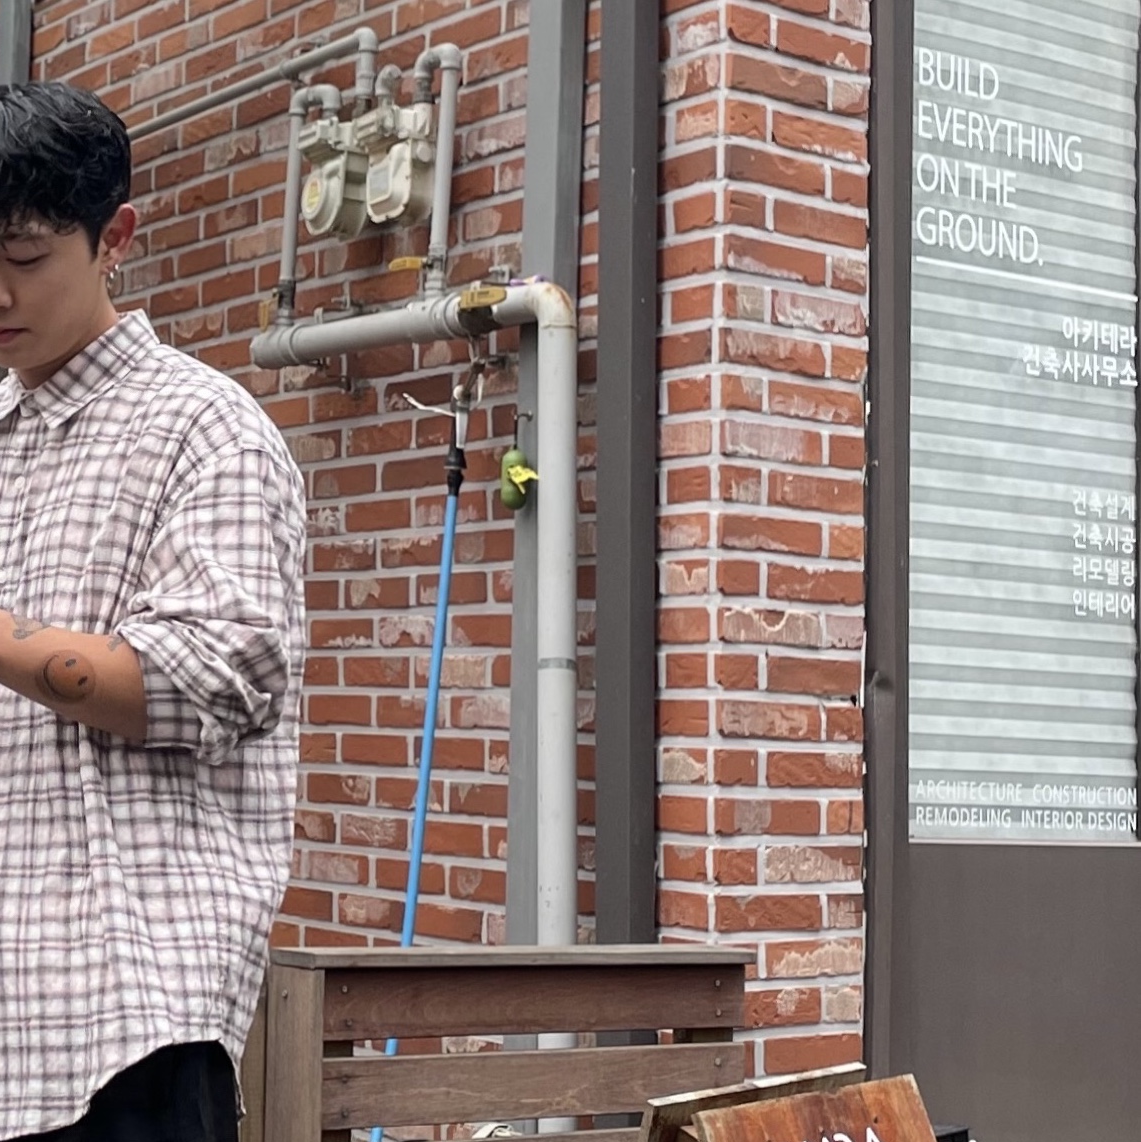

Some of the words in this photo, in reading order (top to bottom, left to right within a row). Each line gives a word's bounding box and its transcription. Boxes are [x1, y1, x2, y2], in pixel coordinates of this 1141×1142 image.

[918, 47, 999, 100] BUILD
[918, 100, 1083, 172] EVERYTHING
[916, 153, 959, 198] ON
[964, 162, 1017, 209] THE
[916, 206, 1044, 266] GROUND.
[1062, 316, 1138, 357] 아키테라
[1073, 522, 1136, 554] 건축시공
[1073, 556, 1136, 587] 리모델링
[1073, 589, 1136, 620] 인테리어
[915, 780, 1023, 802] ARCHITECTURE
[1032, 784, 1137, 806] CONSTRUCTION
[916, 806, 1012, 828] REMODELING
[1021, 809, 1084, 830] INTERIOR
[1088, 811, 1137, 831] DESIGN
